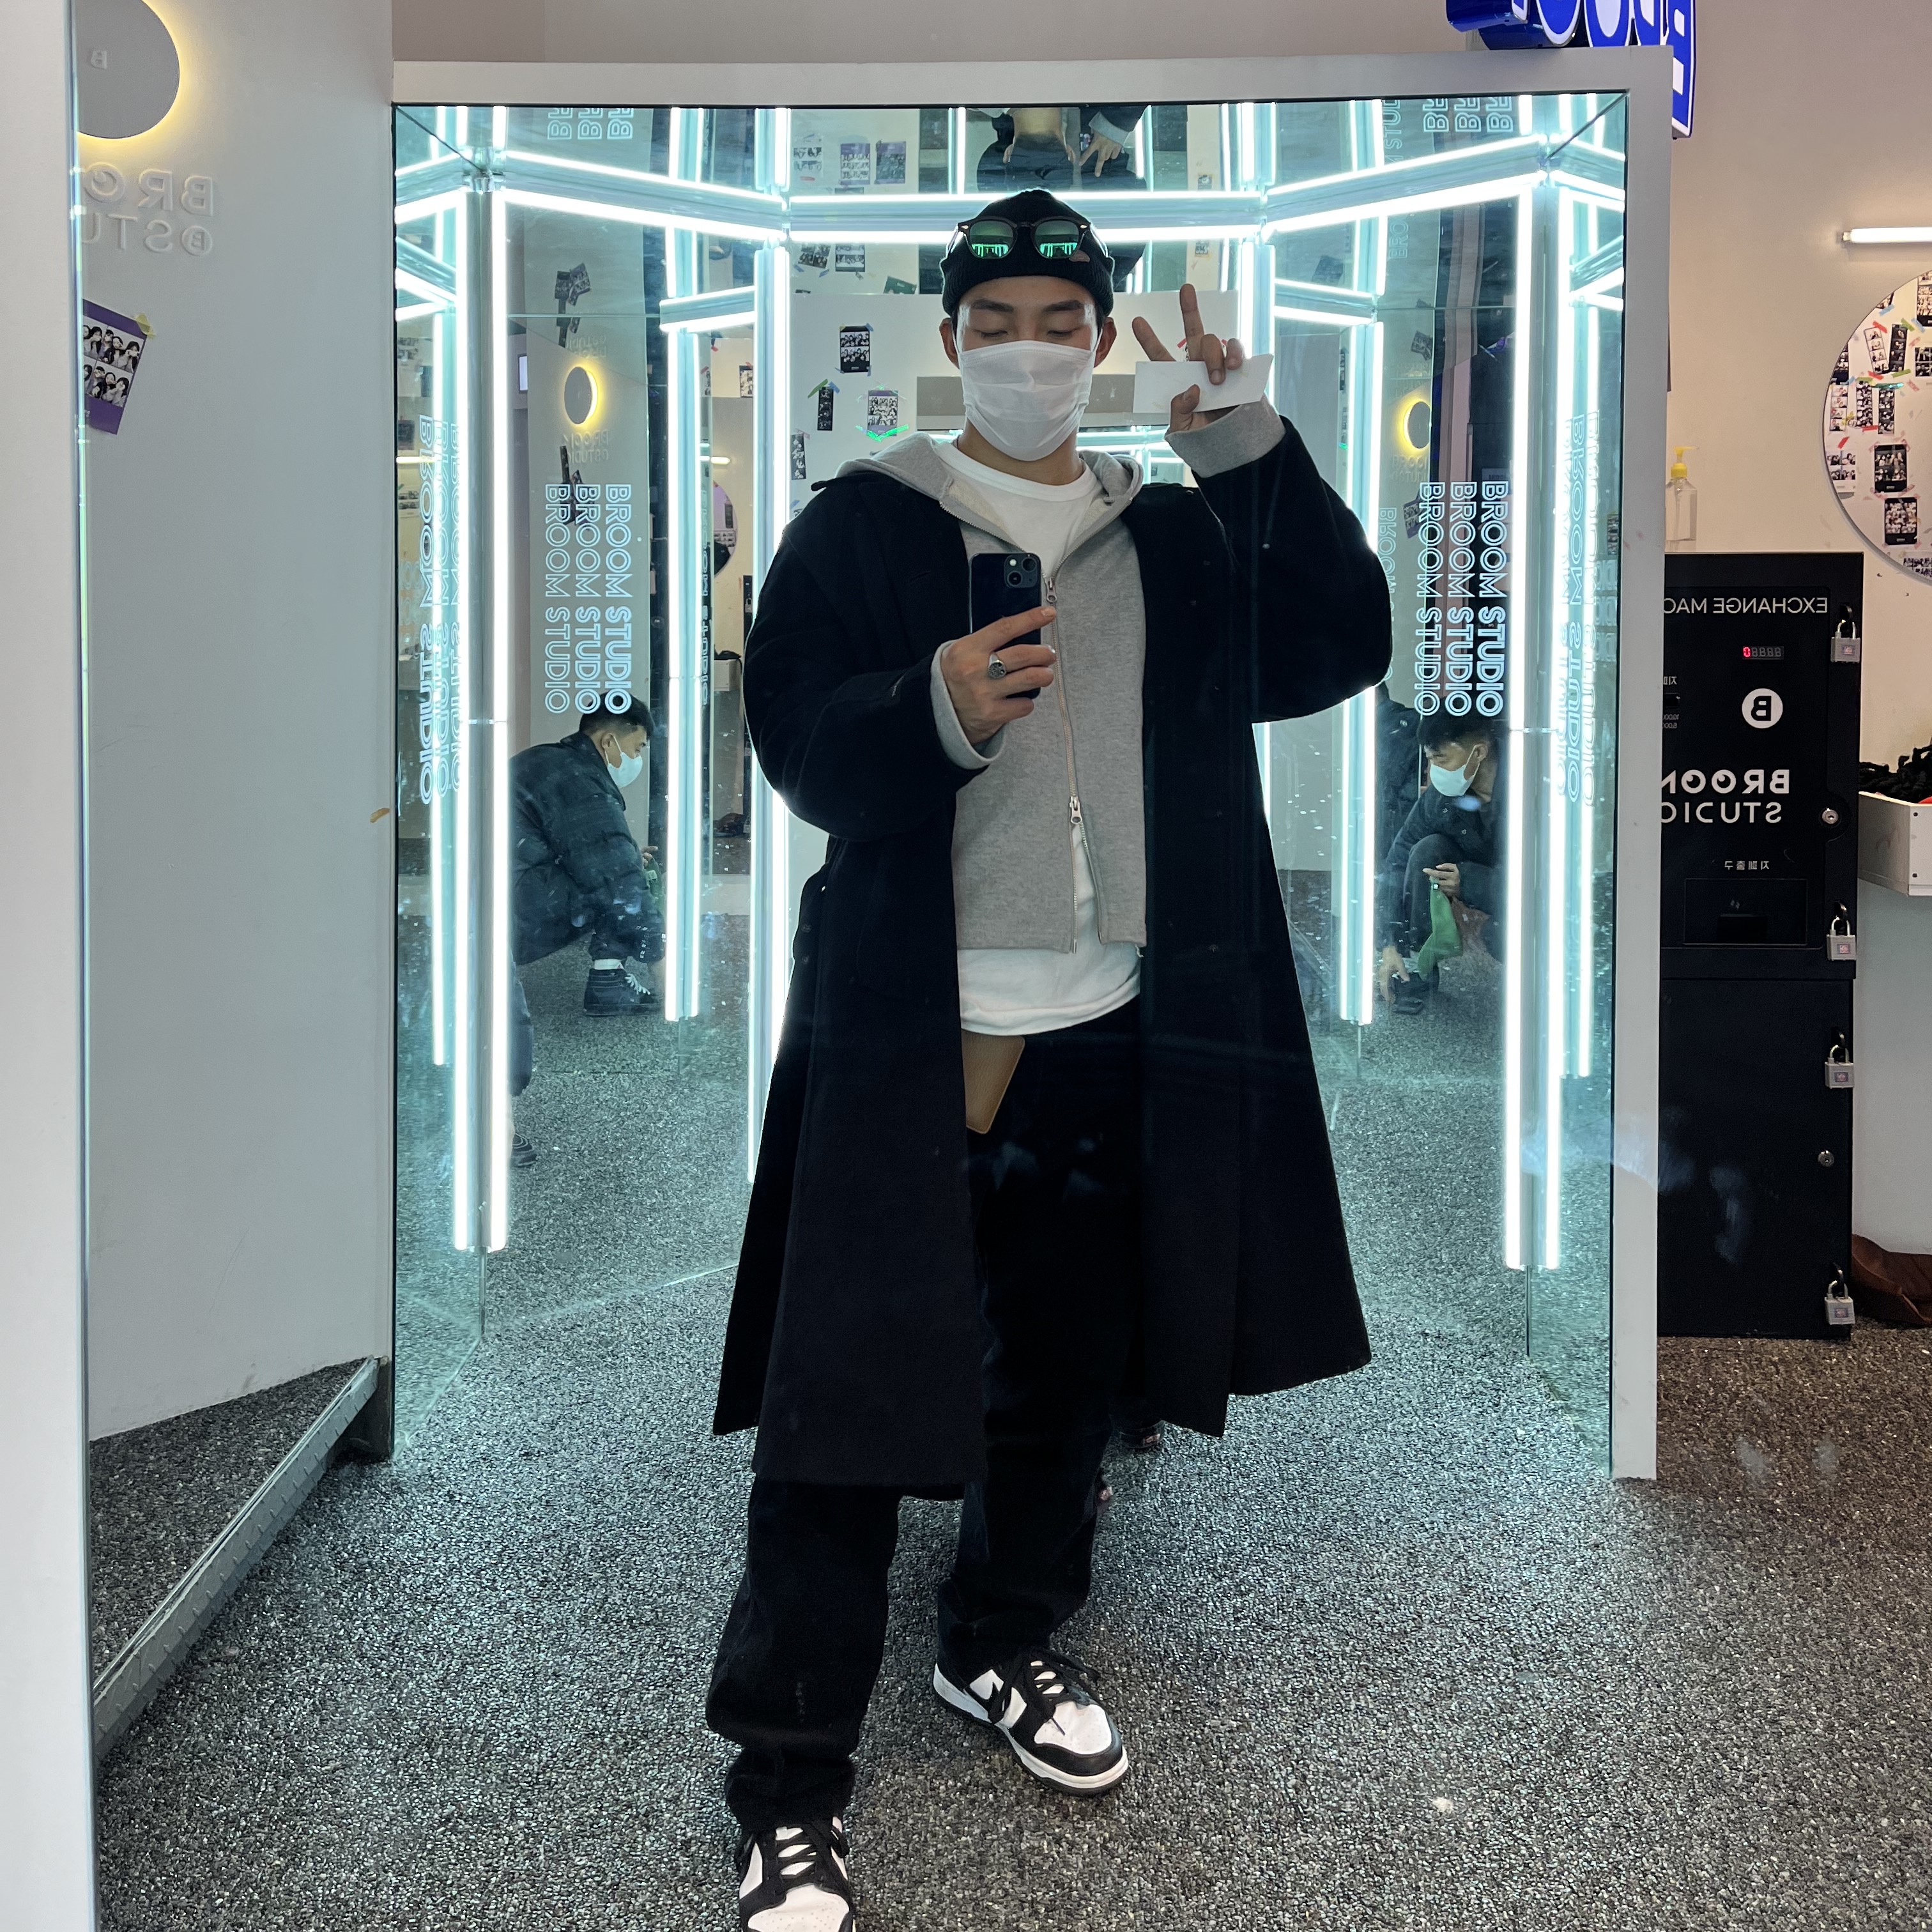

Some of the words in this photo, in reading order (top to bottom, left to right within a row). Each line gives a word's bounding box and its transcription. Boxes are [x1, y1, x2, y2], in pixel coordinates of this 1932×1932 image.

[545, 484, 571, 597] BROOM
[575, 484, 601, 597] BROOM
[605, 484, 633, 597] BROOM
[1416, 481, 1445, 597] BROOM
[1448, 481, 1477, 597] BROOM
[1478, 481, 1508, 597] BROOM
[545, 606, 571, 714] STUDIO
[574, 606, 601, 714] STUDIO
[605, 606, 632, 714] STUDIO
[1414, 606, 1442, 717] STUDIO
[1445, 606, 1475, 717] STUDIO
[1476, 606, 1506, 717] STUDIO
